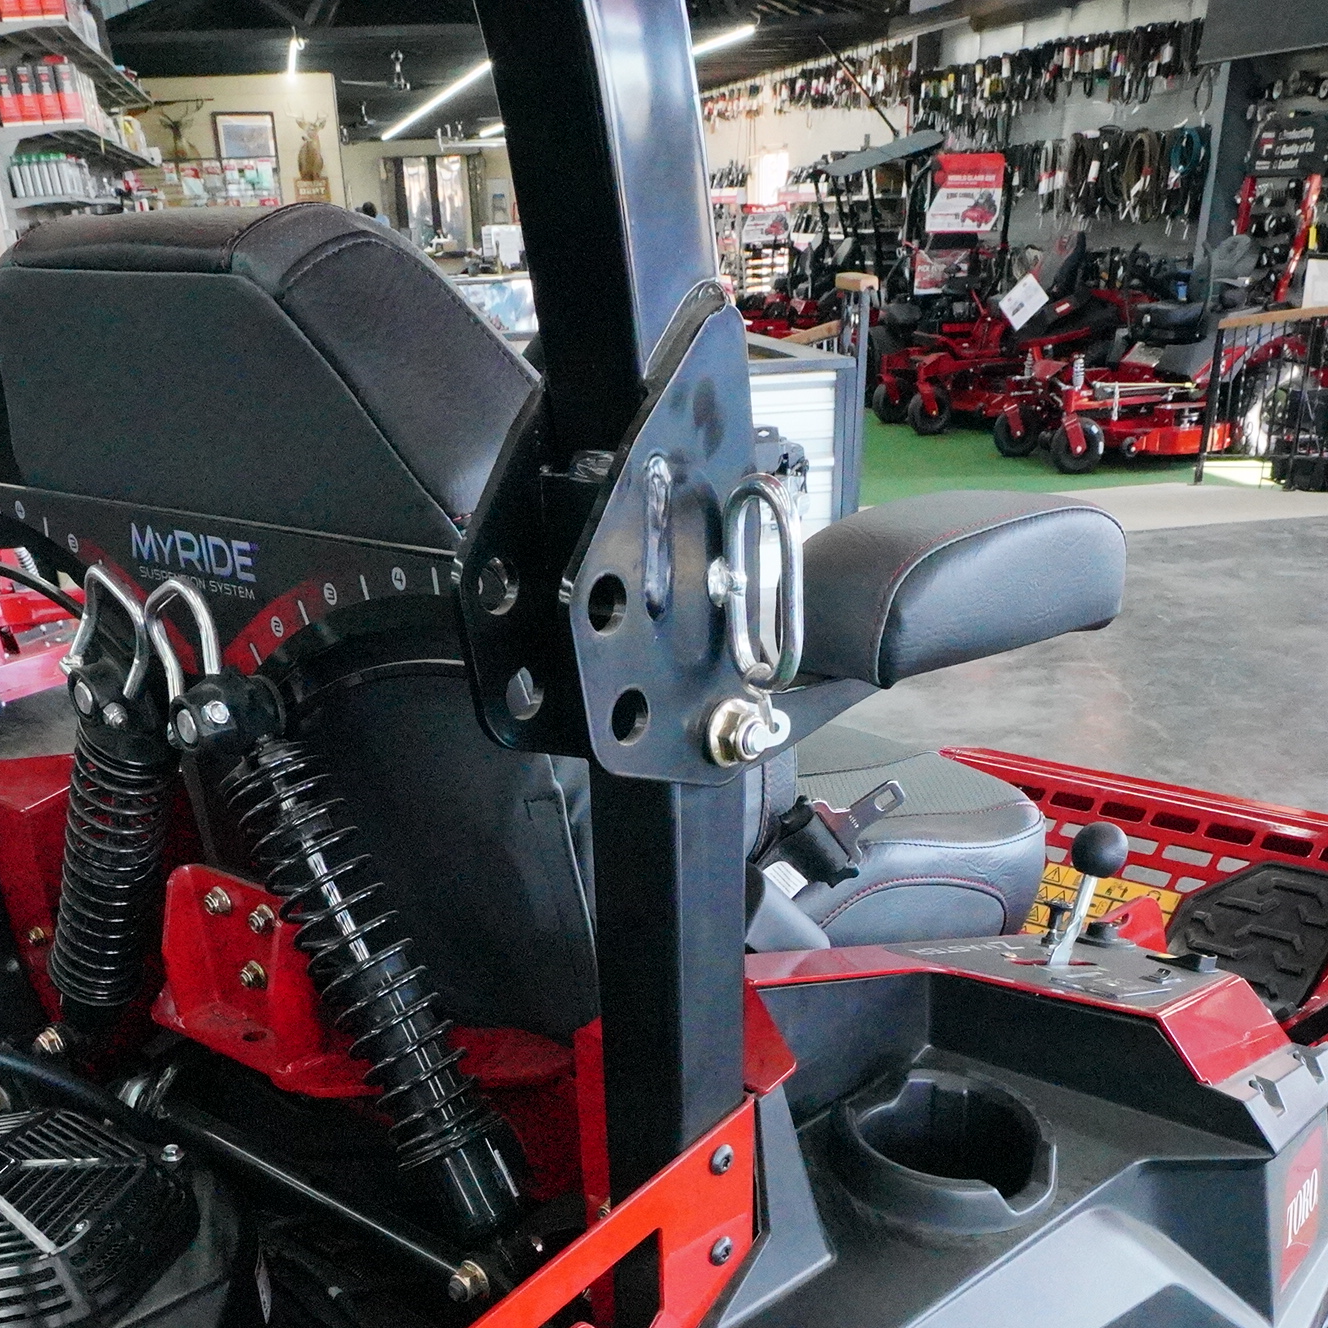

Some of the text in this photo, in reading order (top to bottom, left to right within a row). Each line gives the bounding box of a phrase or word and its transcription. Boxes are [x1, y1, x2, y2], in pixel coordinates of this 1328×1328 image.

[138, 565, 255, 600] SUSPEON SYSTEM
[1286, 1168, 1318, 1248] TORO
